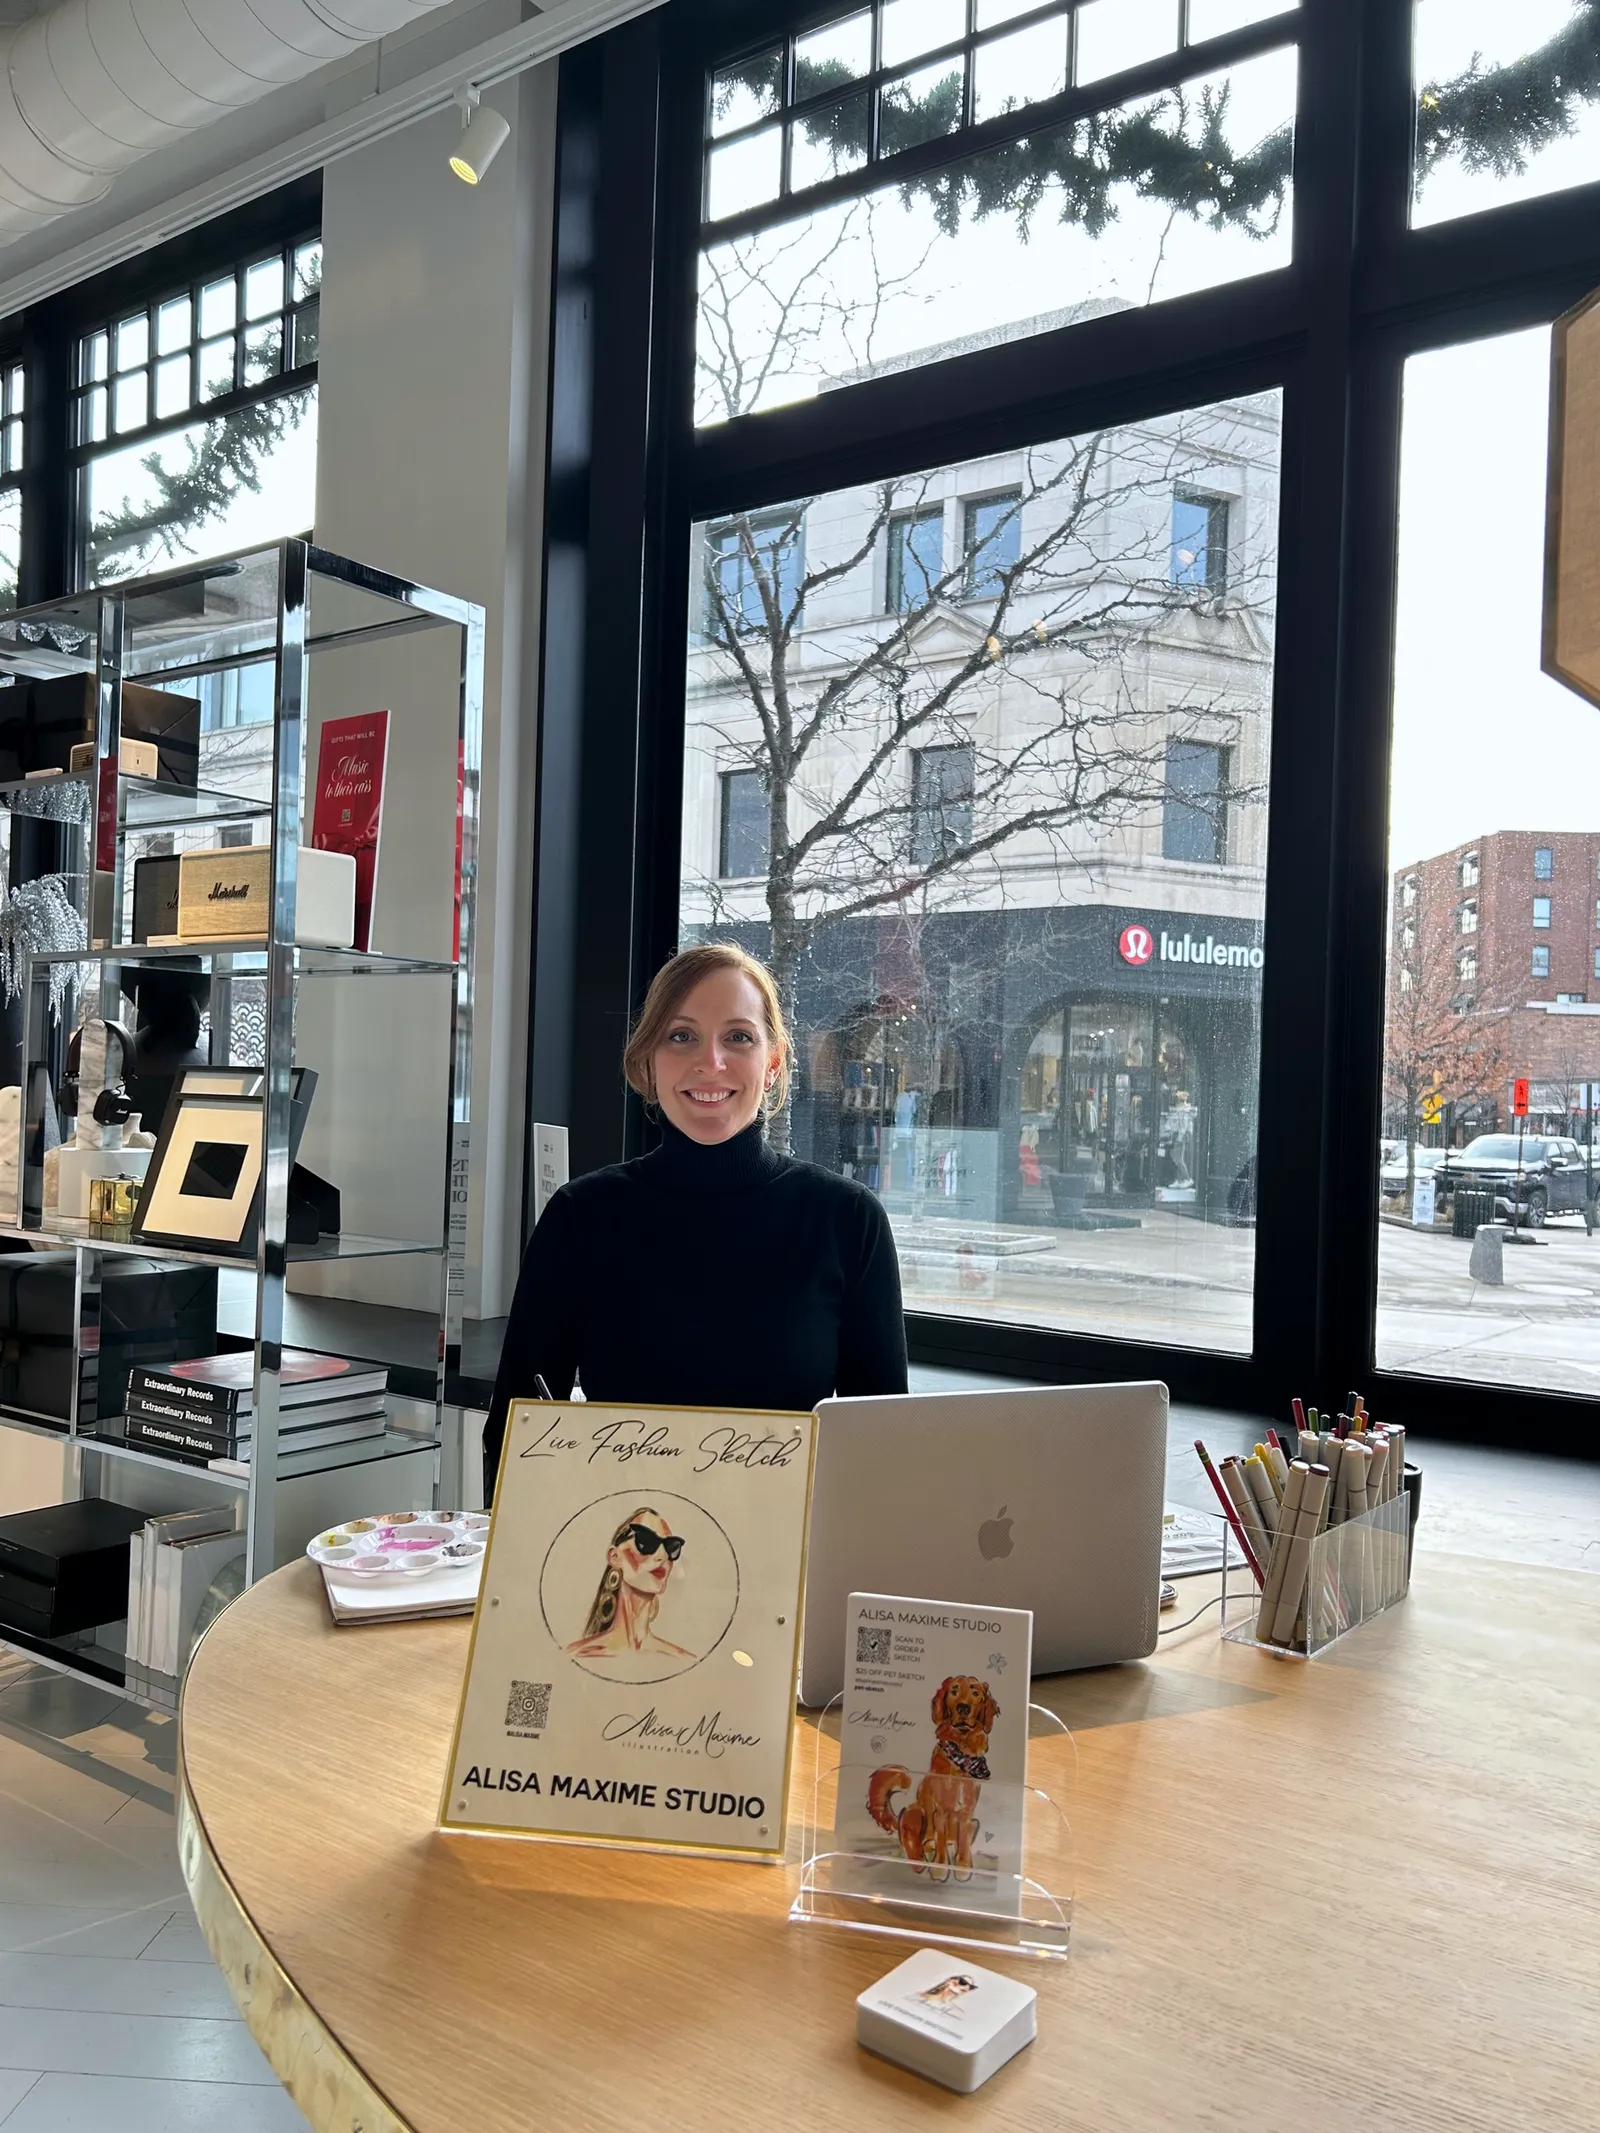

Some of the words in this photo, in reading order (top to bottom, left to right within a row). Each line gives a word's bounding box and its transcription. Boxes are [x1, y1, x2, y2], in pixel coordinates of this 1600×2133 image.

[331, 755, 369, 782] Music
[325, 783, 334, 799] to
[334, 780, 354, 798] their
[354, 779, 372, 795] ears
[207, 882, 250, 901] Marshall
[1160, 931, 1264, 968] lululemo
[144, 1378, 187, 1397] Extraordinary
[187, 1386, 214, 1402] Records
[141, 1400, 184, 1419] Extraordinary
[184, 1409, 213, 1425] Records
[142, 1425, 185, 1444] Extraordinary
[185, 1436, 213, 1451] Records
[519, 1416, 581, 1458] Live
[588, 1420, 685, 1464] Fashion
[693, 1427, 802, 1473] Sketch
[858, 1608, 895, 1623] ALISA
[898, 1613, 950, 1628] MAXIME
[952, 1618, 1002, 1634] STUDIO
[894, 1644, 919, 1653] ORDER
[895, 1635, 914, 1643] SCAN
[915, 1637, 925, 1645] TO
[893, 1653, 921, 1663] SKETCH
[883, 1670, 897, 1678] PET
[898, 1672, 925, 1681] SKETCH
[602, 1707, 683, 1741] Alisa
[676, 1711, 761, 1759] Maxime
[622, 1741, 700, 1755] illustration
[462, 1766, 541, 1794] ALISA
[550, 1775, 657, 1807] MAXIME
[665, 1787, 765, 1819] STUDIO
